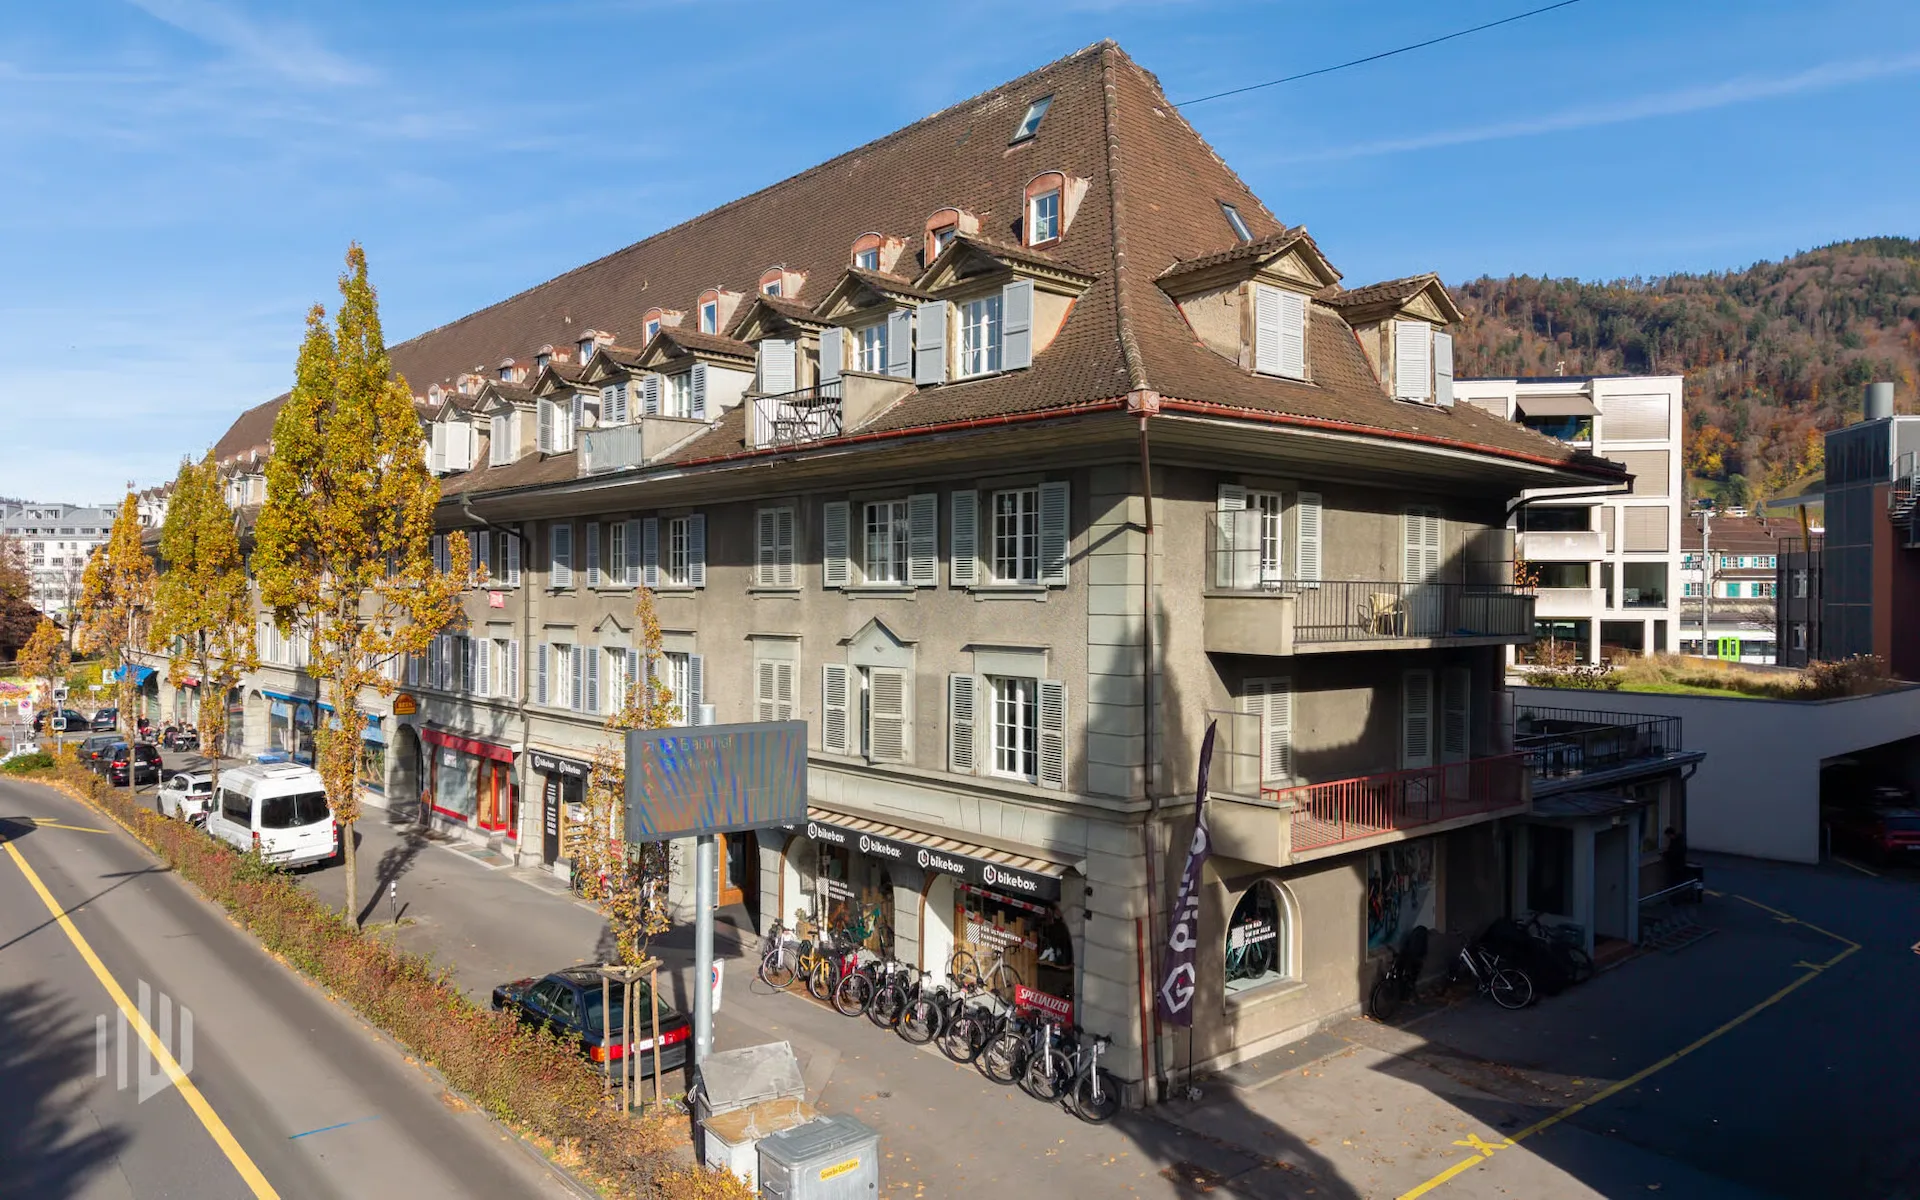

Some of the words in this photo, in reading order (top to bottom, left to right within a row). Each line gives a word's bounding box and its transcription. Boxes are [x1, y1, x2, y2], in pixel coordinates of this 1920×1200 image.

[871, 843, 901, 857] bikebox
[930, 855, 965, 874] bikebox
[998, 872, 1037, 891] bikebox
[1019, 988, 1070, 1014] SPECIALIZED
